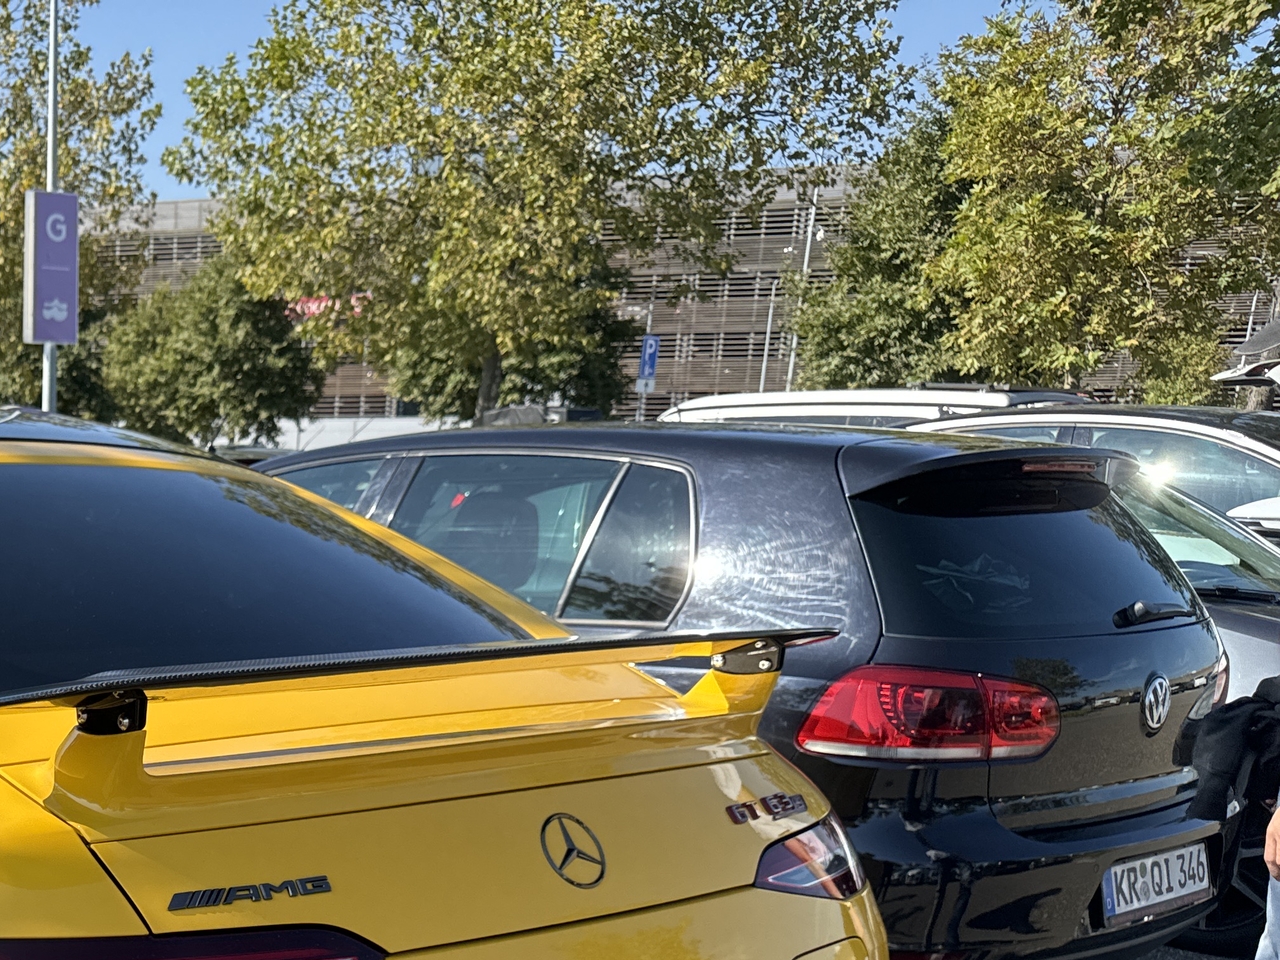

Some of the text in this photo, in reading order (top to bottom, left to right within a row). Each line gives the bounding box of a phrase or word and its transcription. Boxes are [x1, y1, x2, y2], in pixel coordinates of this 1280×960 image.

[45, 212, 67, 243] G
[645, 340, 656, 361] P
[725, 801, 760, 825] GT
[222, 875, 332, 905] AMG
[1113, 848, 1206, 907] KR QI 346
[1106, 898, 1112, 910] D
